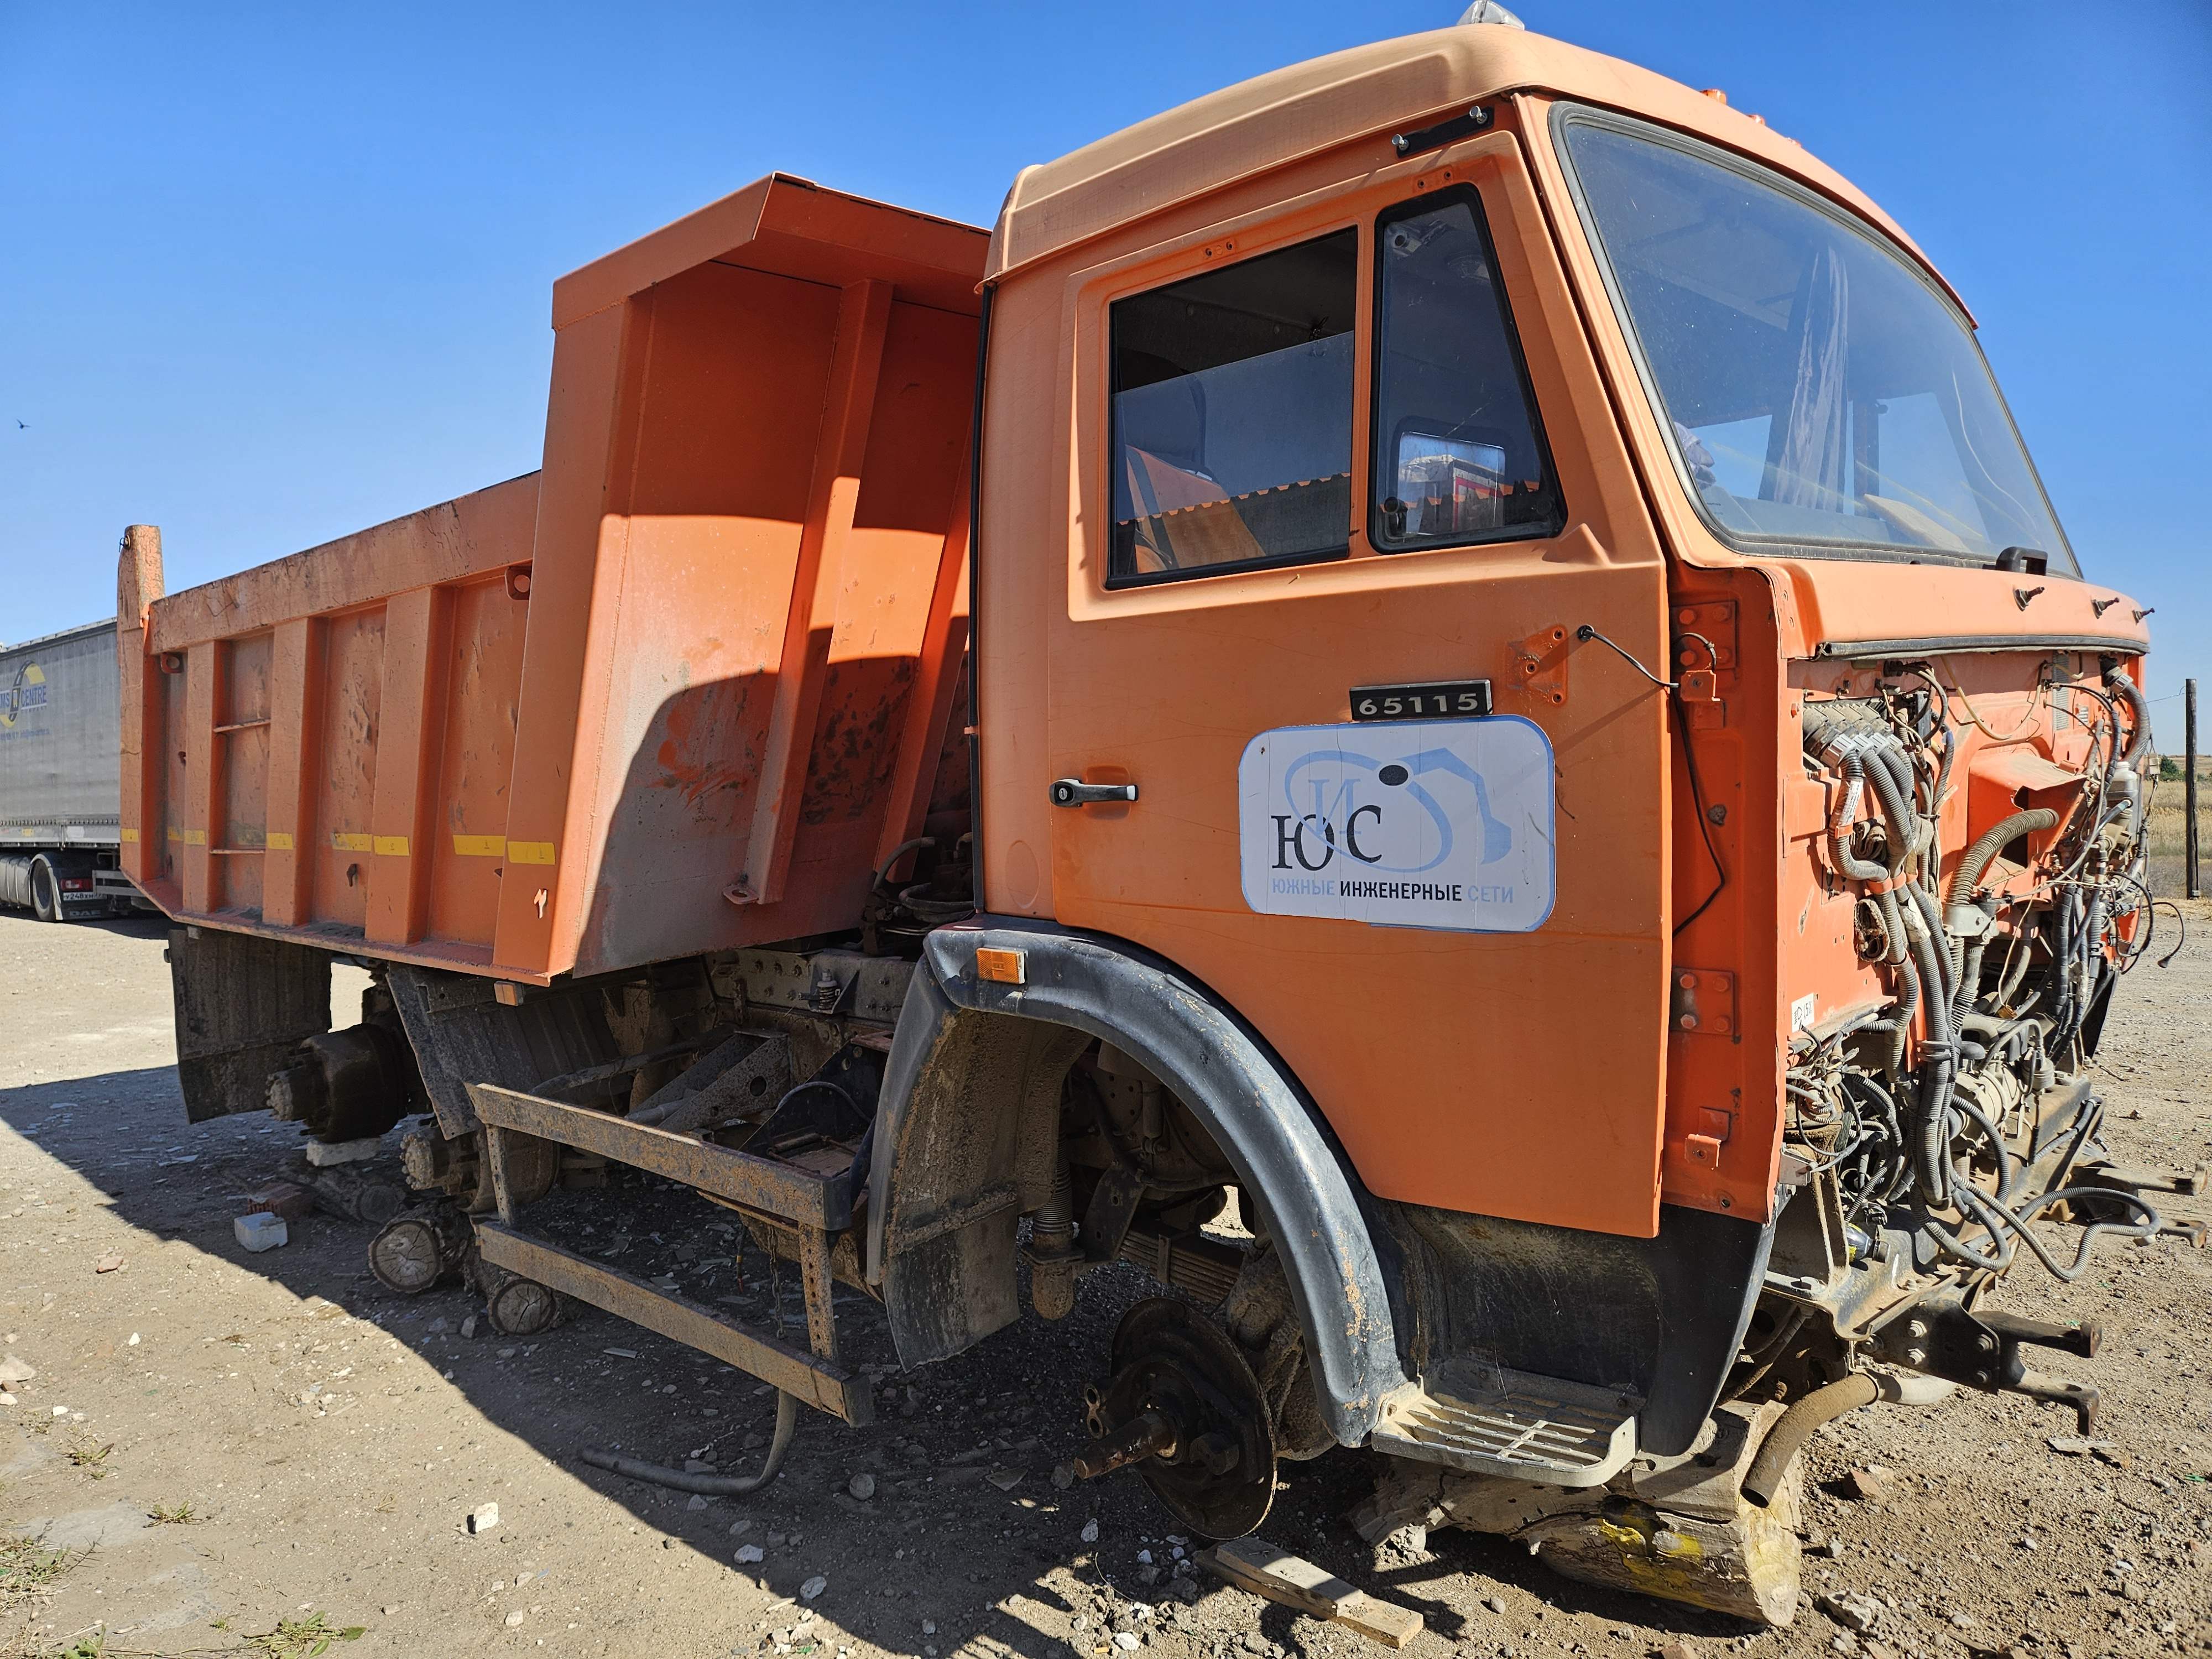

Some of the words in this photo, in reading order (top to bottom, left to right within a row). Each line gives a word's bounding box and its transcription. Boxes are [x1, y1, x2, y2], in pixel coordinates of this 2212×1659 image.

[0, 693, 10, 708] MS
[20, 685, 47, 707] CENTRE
[1359, 692, 1478, 715] 65115
[1272, 878, 1335, 896] ЮЖНЫЕ
[1340, 880, 1462, 901] ИНЖЕНЕРНЫЕ
[1468, 885, 1514, 904] СЕТИ
